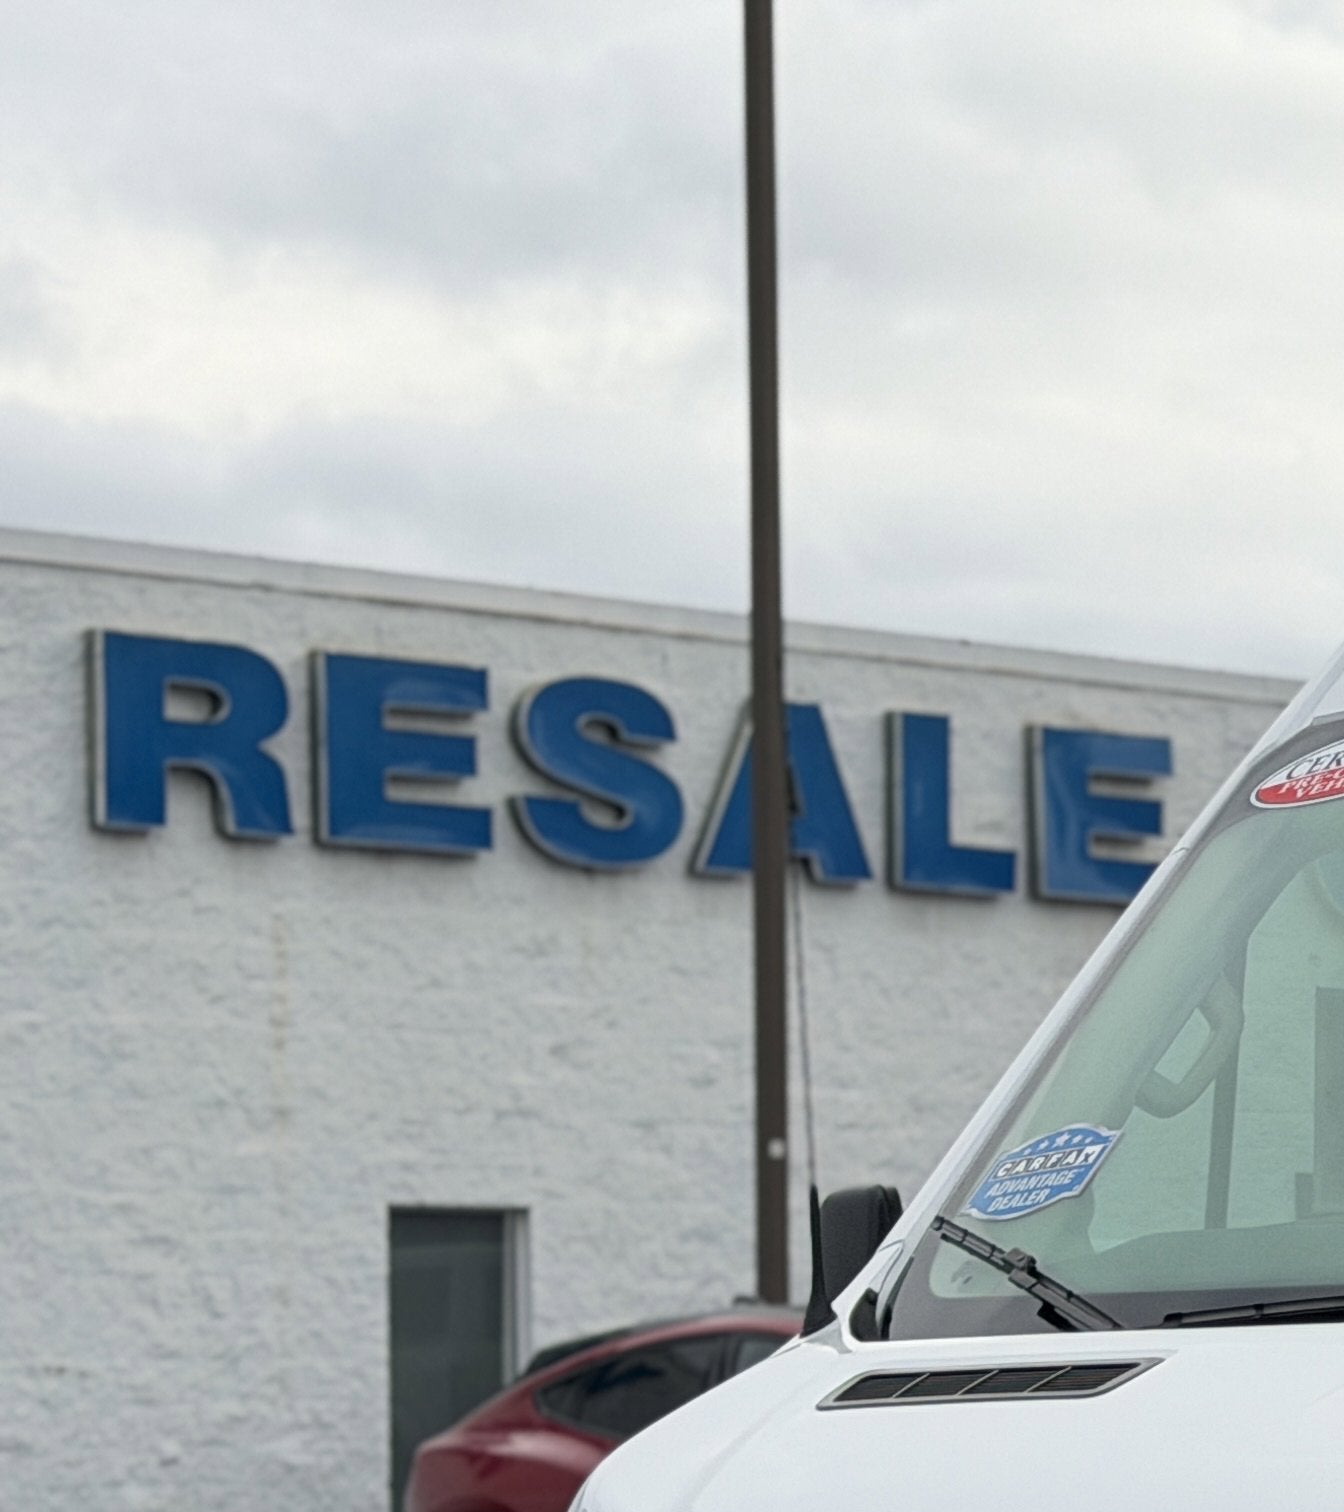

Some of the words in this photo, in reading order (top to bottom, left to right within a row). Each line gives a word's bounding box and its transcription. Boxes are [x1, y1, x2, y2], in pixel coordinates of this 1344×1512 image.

[86, 628, 1175, 904] RESALE
[997, 1147, 1101, 1177] CARFAX
[985, 1169, 1077, 1199] ADVANTAGE
[986, 1188, 1051, 1213] DEALER
